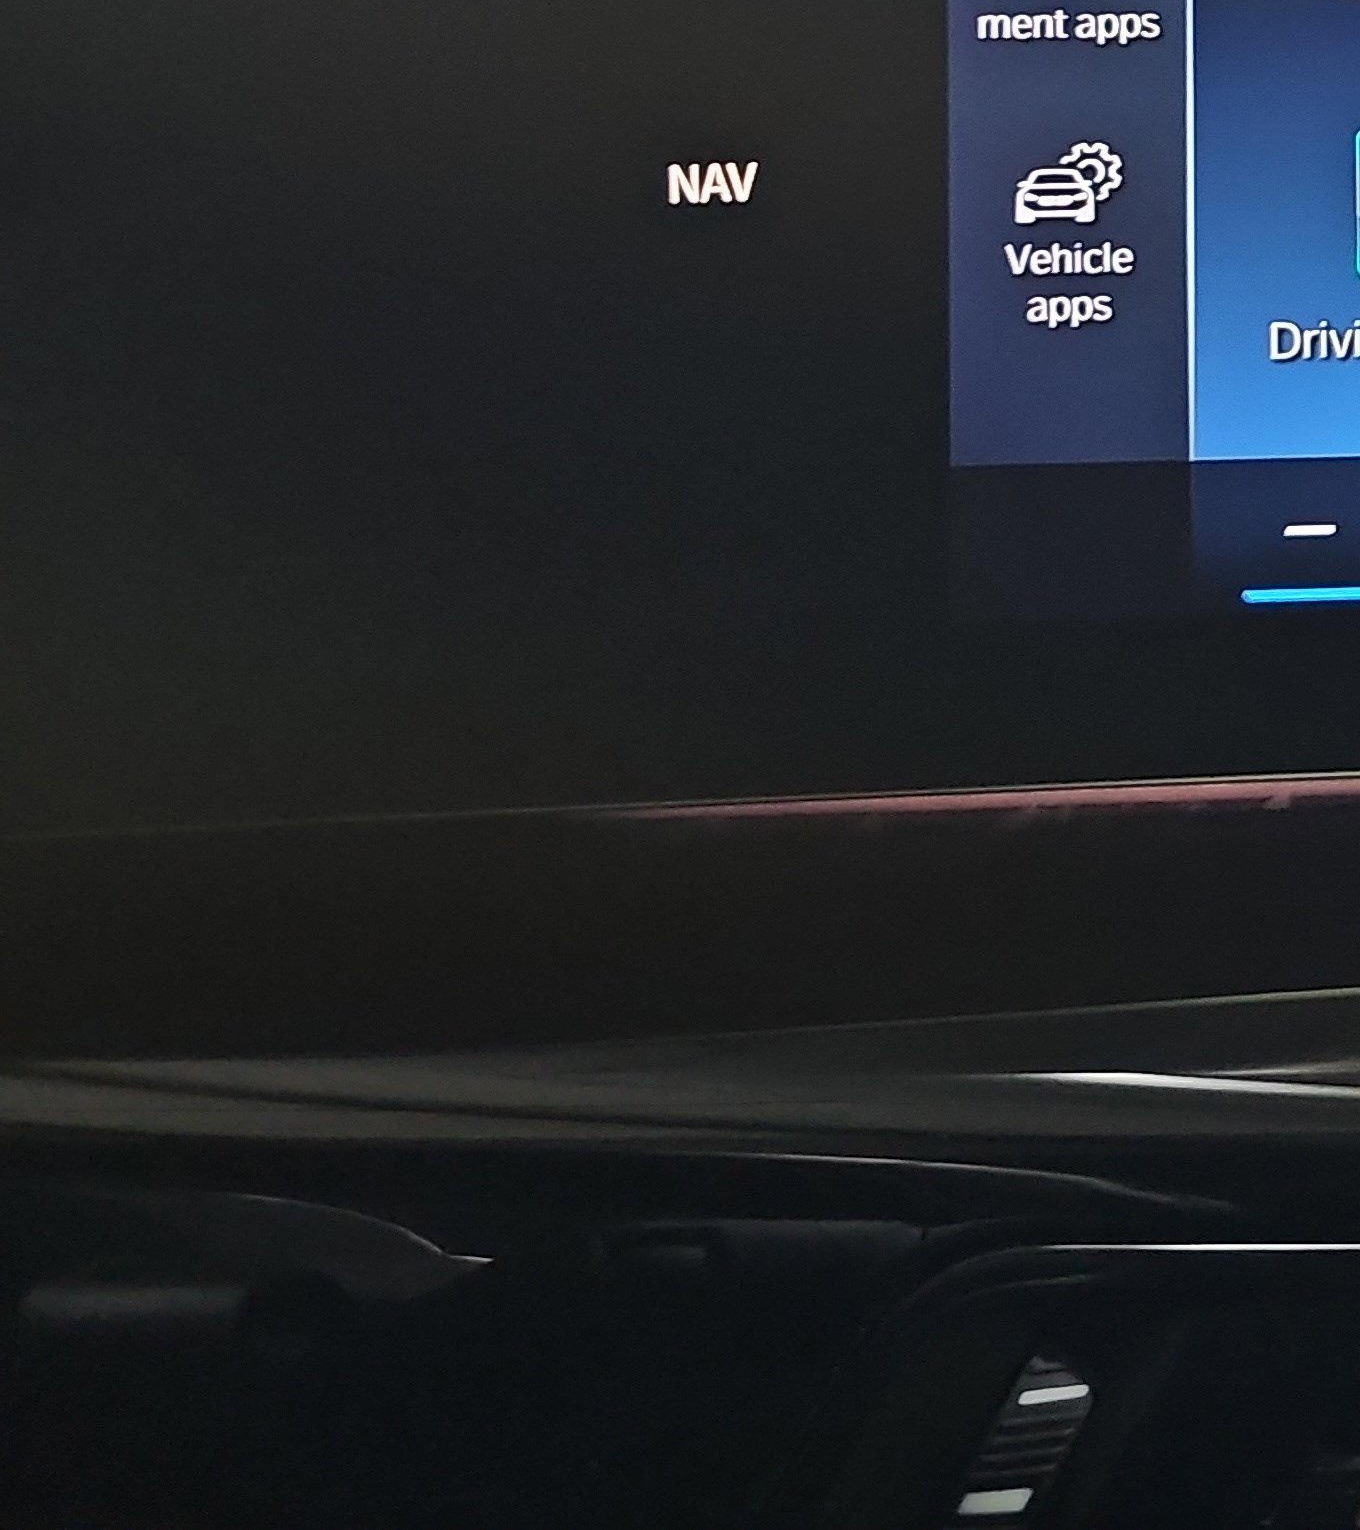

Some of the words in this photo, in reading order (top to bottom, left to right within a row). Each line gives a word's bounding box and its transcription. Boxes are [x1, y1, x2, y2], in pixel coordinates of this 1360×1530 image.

[977, 9, 1069, 40] ment
[1074, 13, 1161, 45] apps
[668, 161, 758, 205] NAV
[1003, 241, 1134, 275] Vehicle
[1026, 295, 1113, 329] apps
